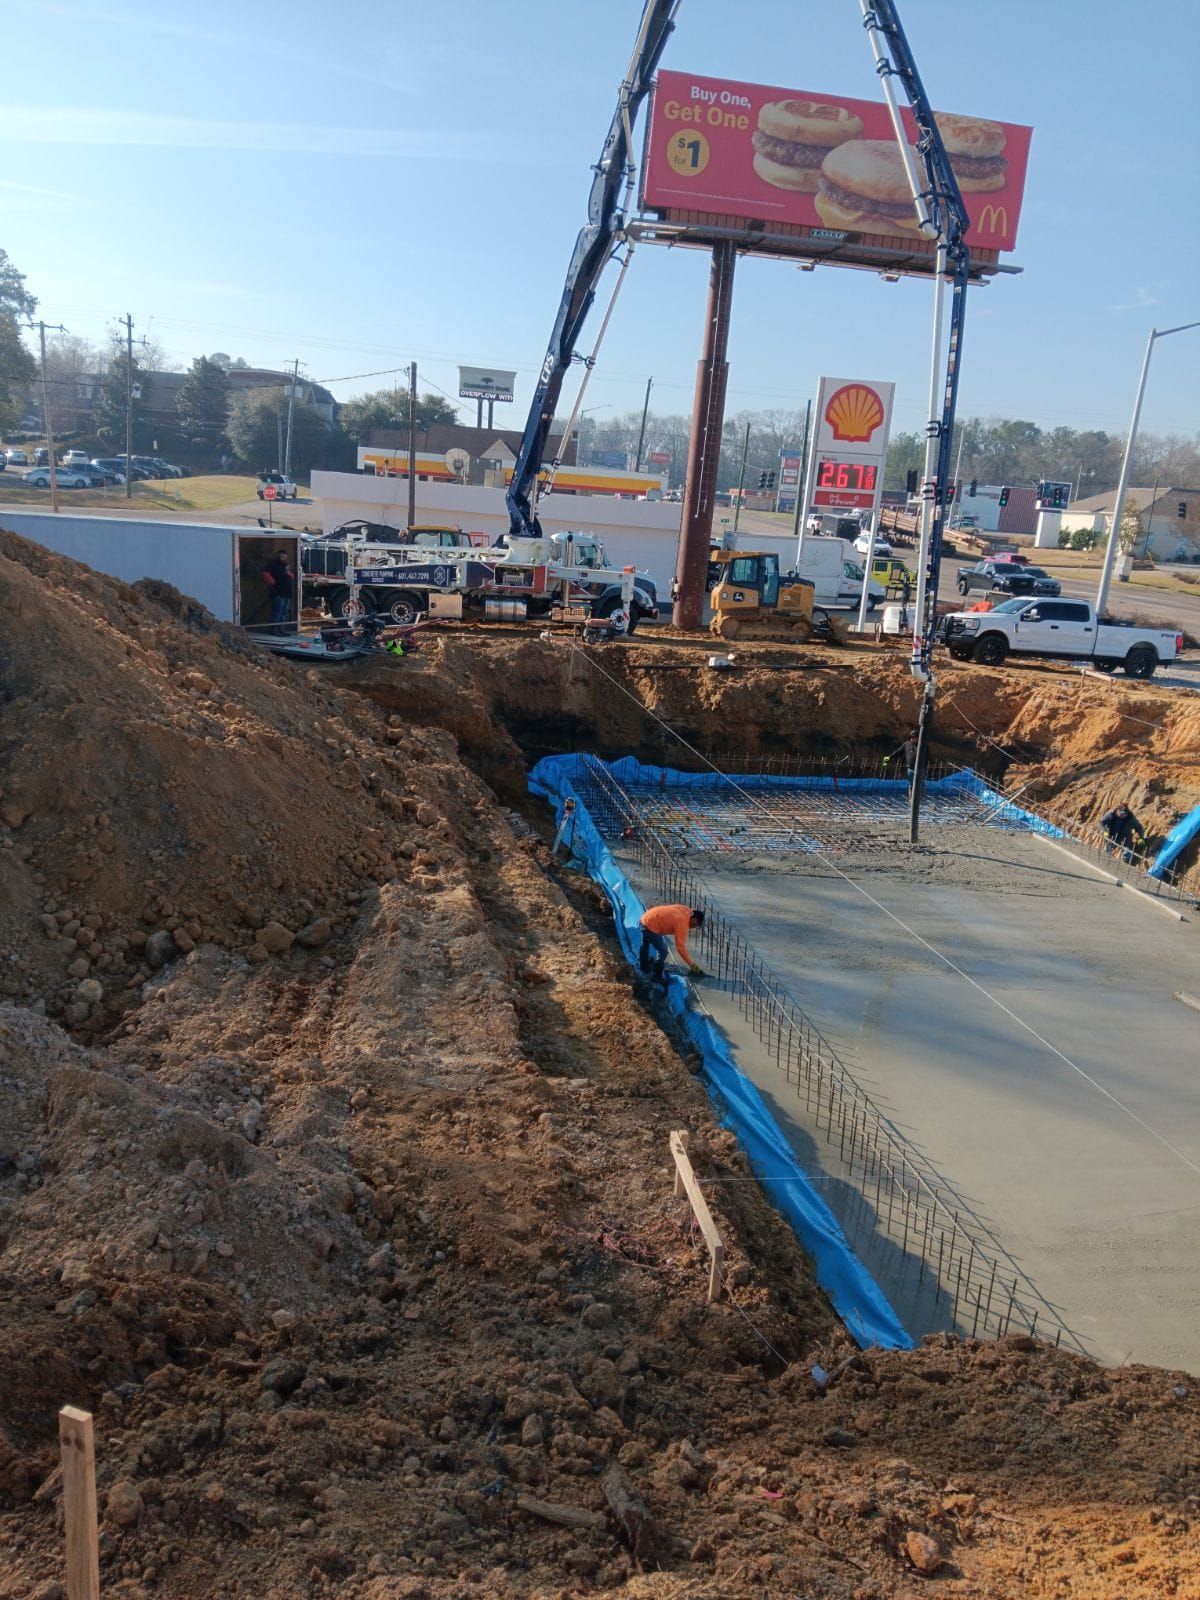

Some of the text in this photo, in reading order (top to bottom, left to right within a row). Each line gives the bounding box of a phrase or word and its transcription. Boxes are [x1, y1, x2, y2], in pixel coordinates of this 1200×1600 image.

[691, 86, 752, 109] Buy One,
[664, 100, 749, 130] Get One
[674, 155, 687, 165] for
[540, 351, 554, 384] CPS
